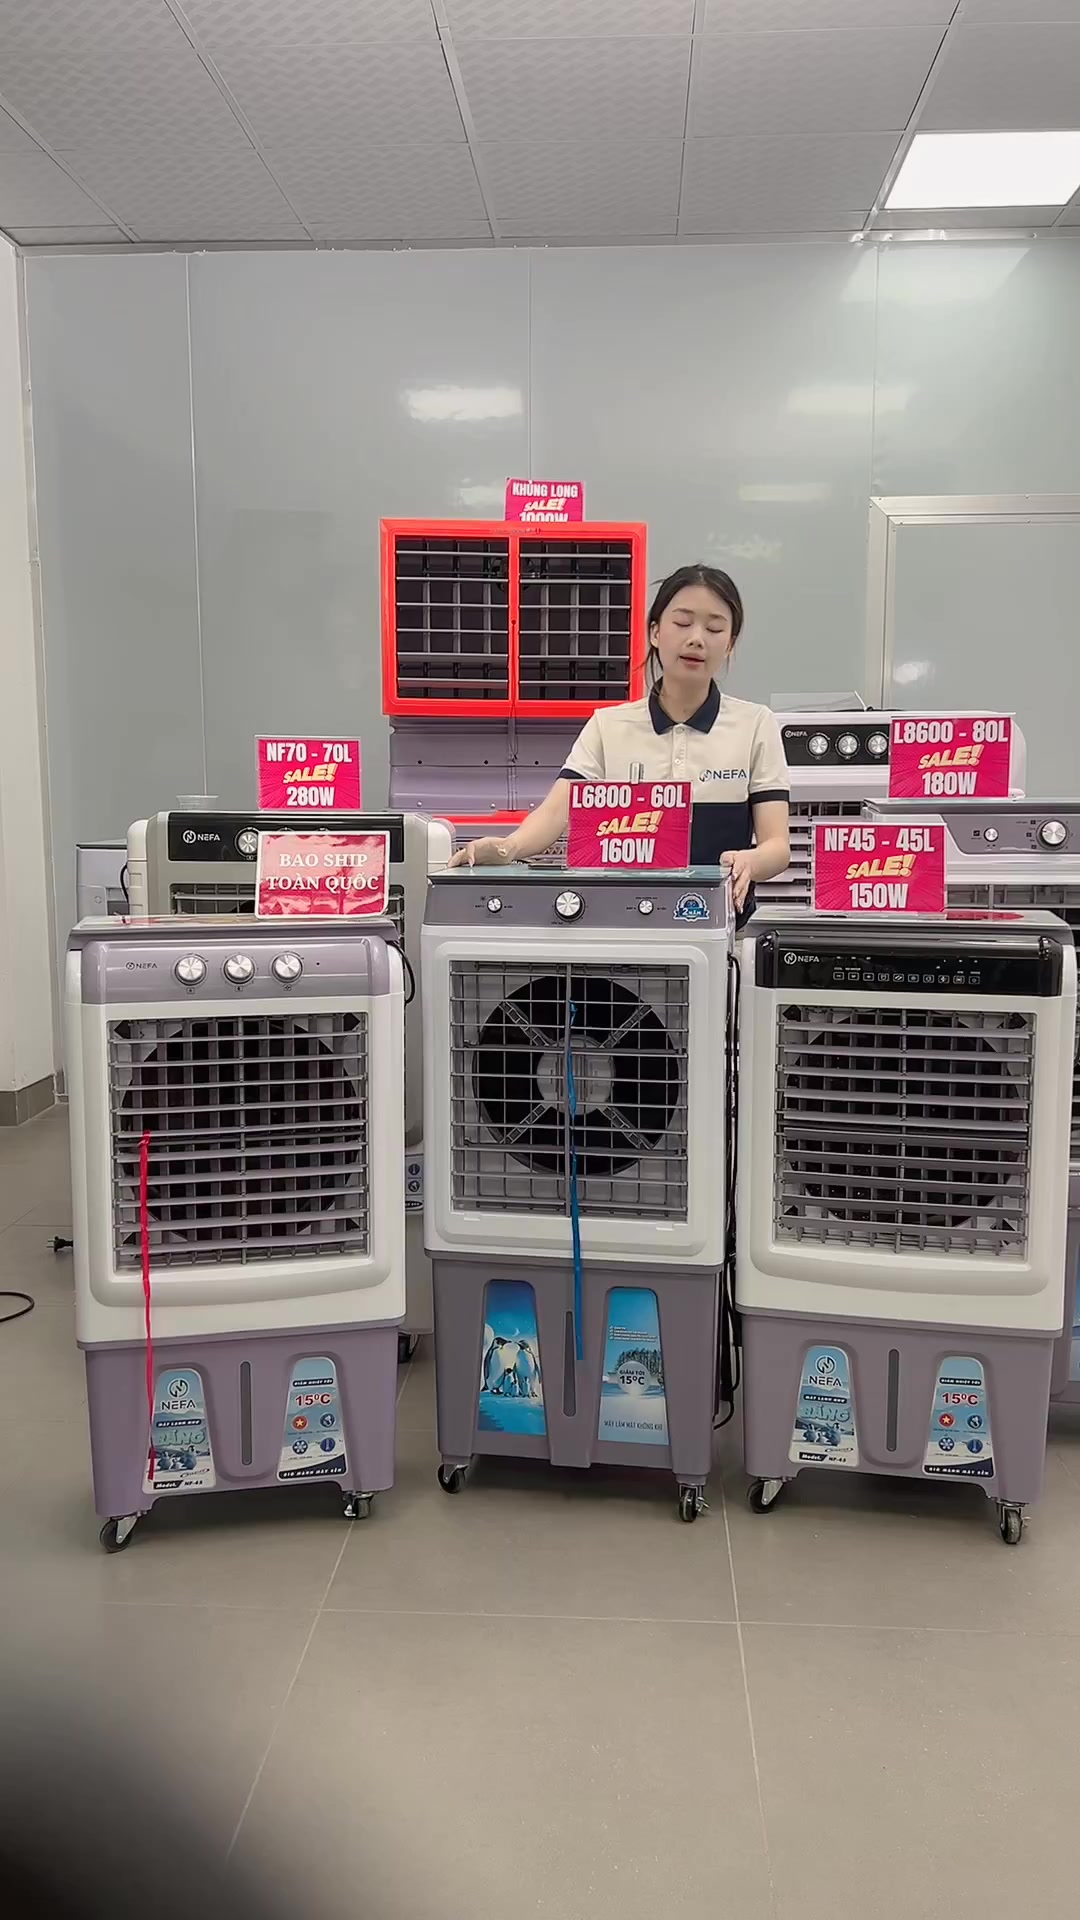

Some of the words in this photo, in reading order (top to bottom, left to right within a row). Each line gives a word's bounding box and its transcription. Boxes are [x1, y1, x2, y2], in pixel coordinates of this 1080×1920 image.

[512, 480, 548, 497] KHỦNG
[550, 484, 578, 498] LONG
[523, 498, 567, 511] SALE!
[893, 722, 953, 744] L8600
[972, 721, 1008, 742] 80L
[266, 742, 307, 762] NF70
[322, 743, 352, 763] 70L
[918, 744, 984, 769] SALE!
[282, 763, 338, 783] SALE!
[713, 769, 747, 779] NEFA
[921, 771, 977, 795] 180W
[286, 786, 335, 806] 280W
[572, 784, 632, 808] L6800
[651, 784, 686, 808] 60L
[596, 810, 664, 836] SALE!
[197, 833, 220, 841] NEFA
[824, 828, 875, 852] NF45
[895, 828, 935, 852] 45L
[279, 853, 318, 867] BAO
[323, 853, 368, 867] SHIP
[599, 838, 656, 863] 160W
[845, 854, 917, 879] SALE!
[265, 871, 320, 890] TOÀN
[325, 871, 379, 893] QUỐC
[848, 883, 908, 909] 150W
[797, 955, 820, 963] NEFA
[809, 1376, 842, 1387] NEFA
[161, 1399, 196, 1410] NEFA
